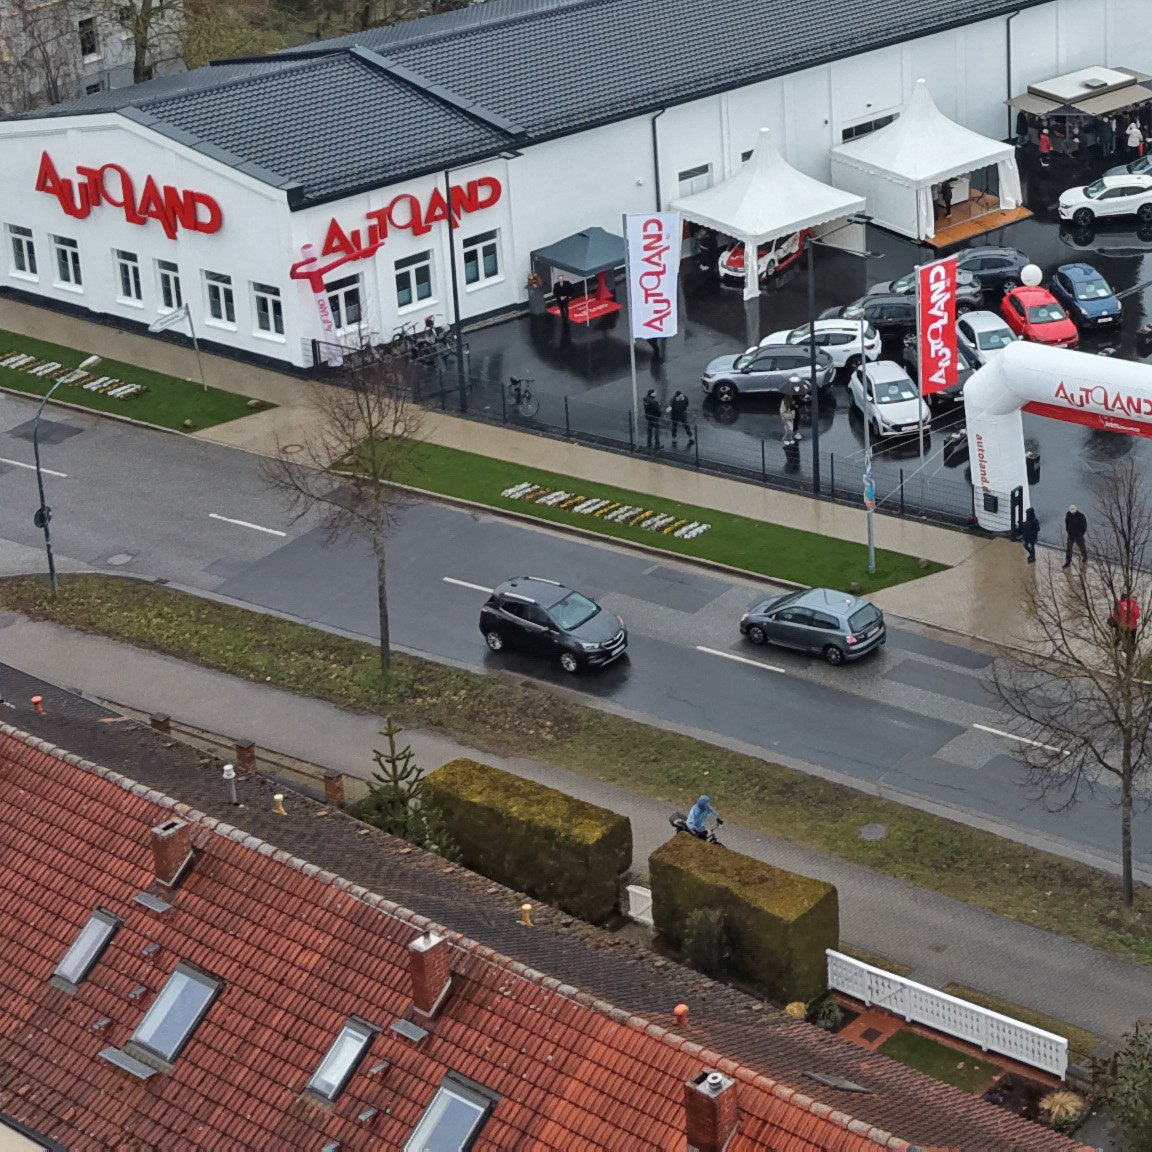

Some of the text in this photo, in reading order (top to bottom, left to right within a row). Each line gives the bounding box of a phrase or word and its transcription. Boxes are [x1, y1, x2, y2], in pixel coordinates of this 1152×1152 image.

[36, 151, 222, 240] AUTOLAND
[321, 176, 502, 257] AUTOLAND
[639, 218, 671, 332] AUTOLAND
[927, 265, 951, 384] AUTOLAND
[976, 433, 990, 494] autoland.d
